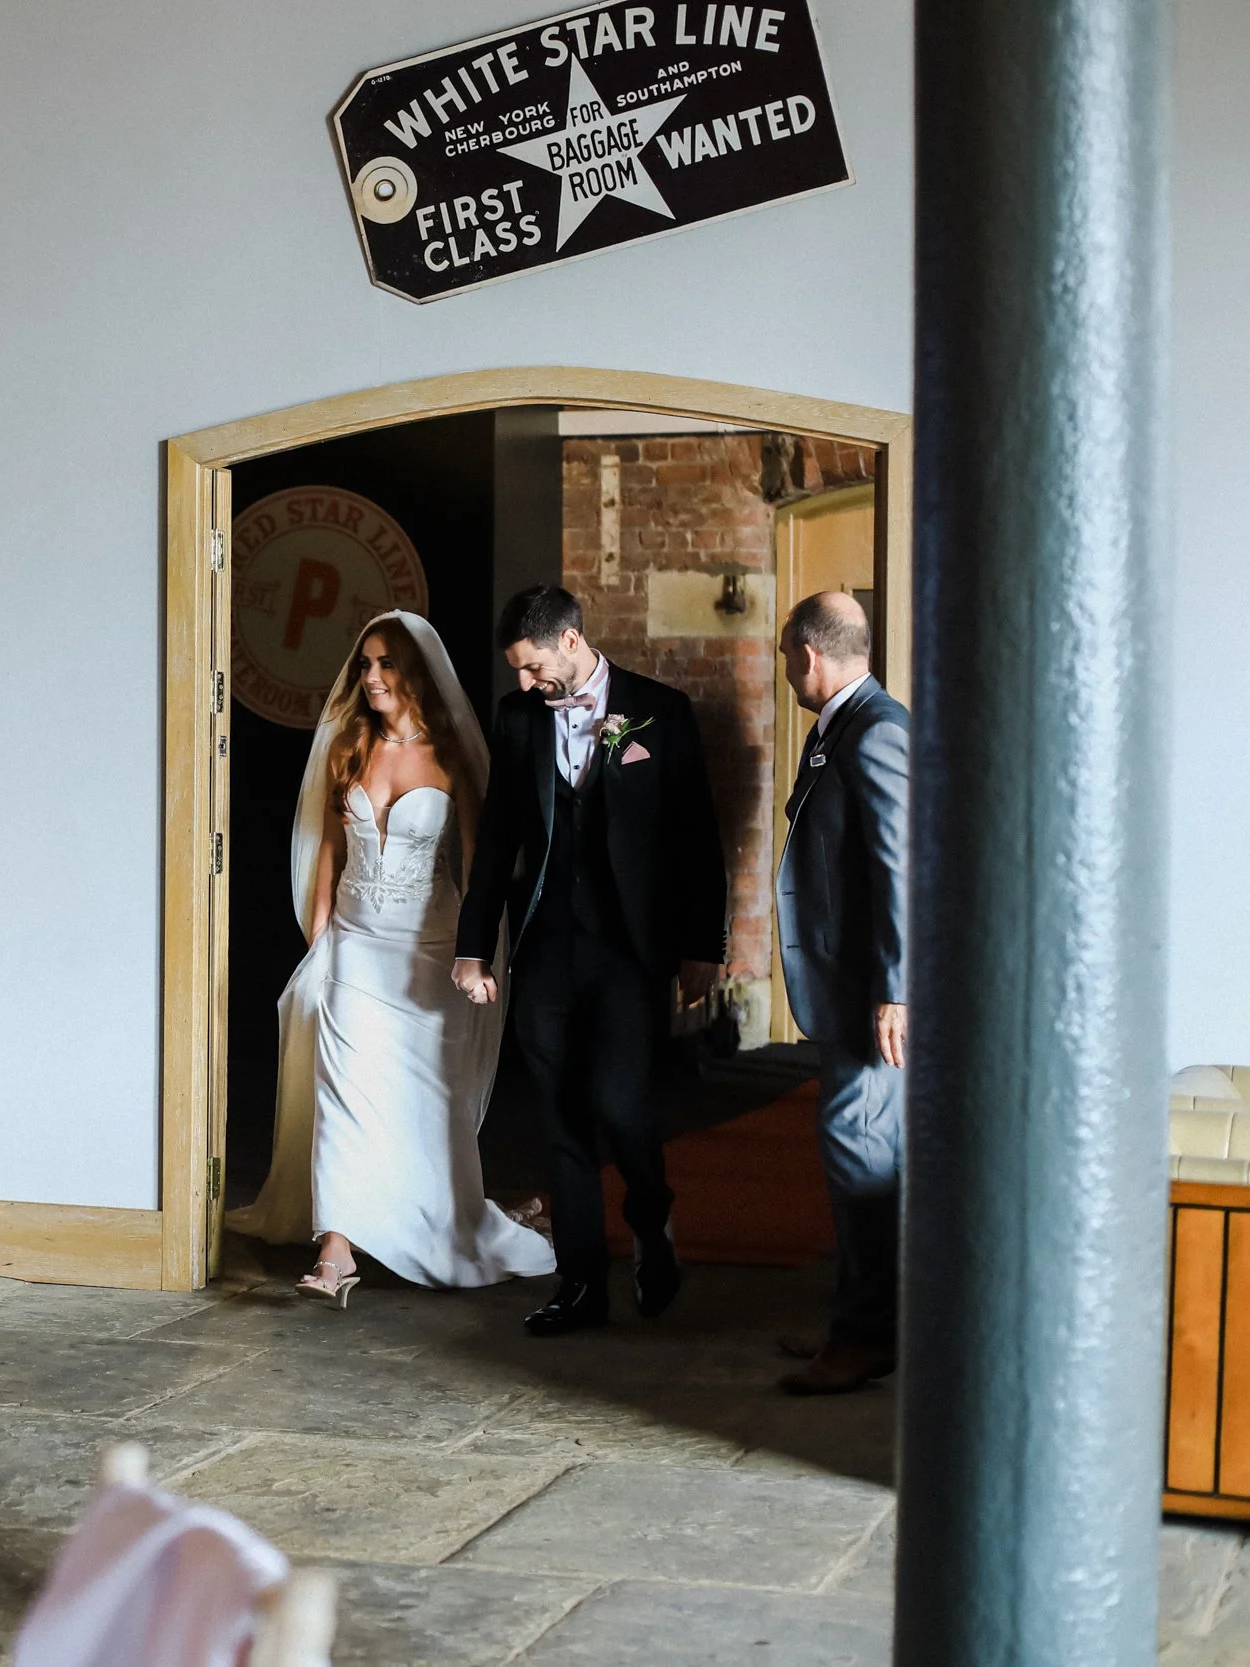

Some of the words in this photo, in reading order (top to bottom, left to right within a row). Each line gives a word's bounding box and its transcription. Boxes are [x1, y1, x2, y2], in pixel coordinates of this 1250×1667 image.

[383, 42, 530, 150] WHITE
[539, 6, 656, 68] STAR
[675, 4, 787, 53] LINE
[616, 60, 743, 107] SOUTHAMPTON
[656, 60, 690, 80] AND
[444, 119, 484, 143] NEW
[498, 101, 551, 126] YORK
[444, 115, 556, 158] CHERBOURG
[570, 100, 603, 127] FOR
[655, 94, 817, 170] WANTED
[549, 117, 644, 172] BAGGAGE
[569, 157, 639, 202] ROOM
[415, 179, 526, 241] FIRST
[424, 213, 542, 272] CLASS
[286, 496, 366, 535] STAR
[368, 524, 418, 603] LINE
[282, 557, 342, 651] P
